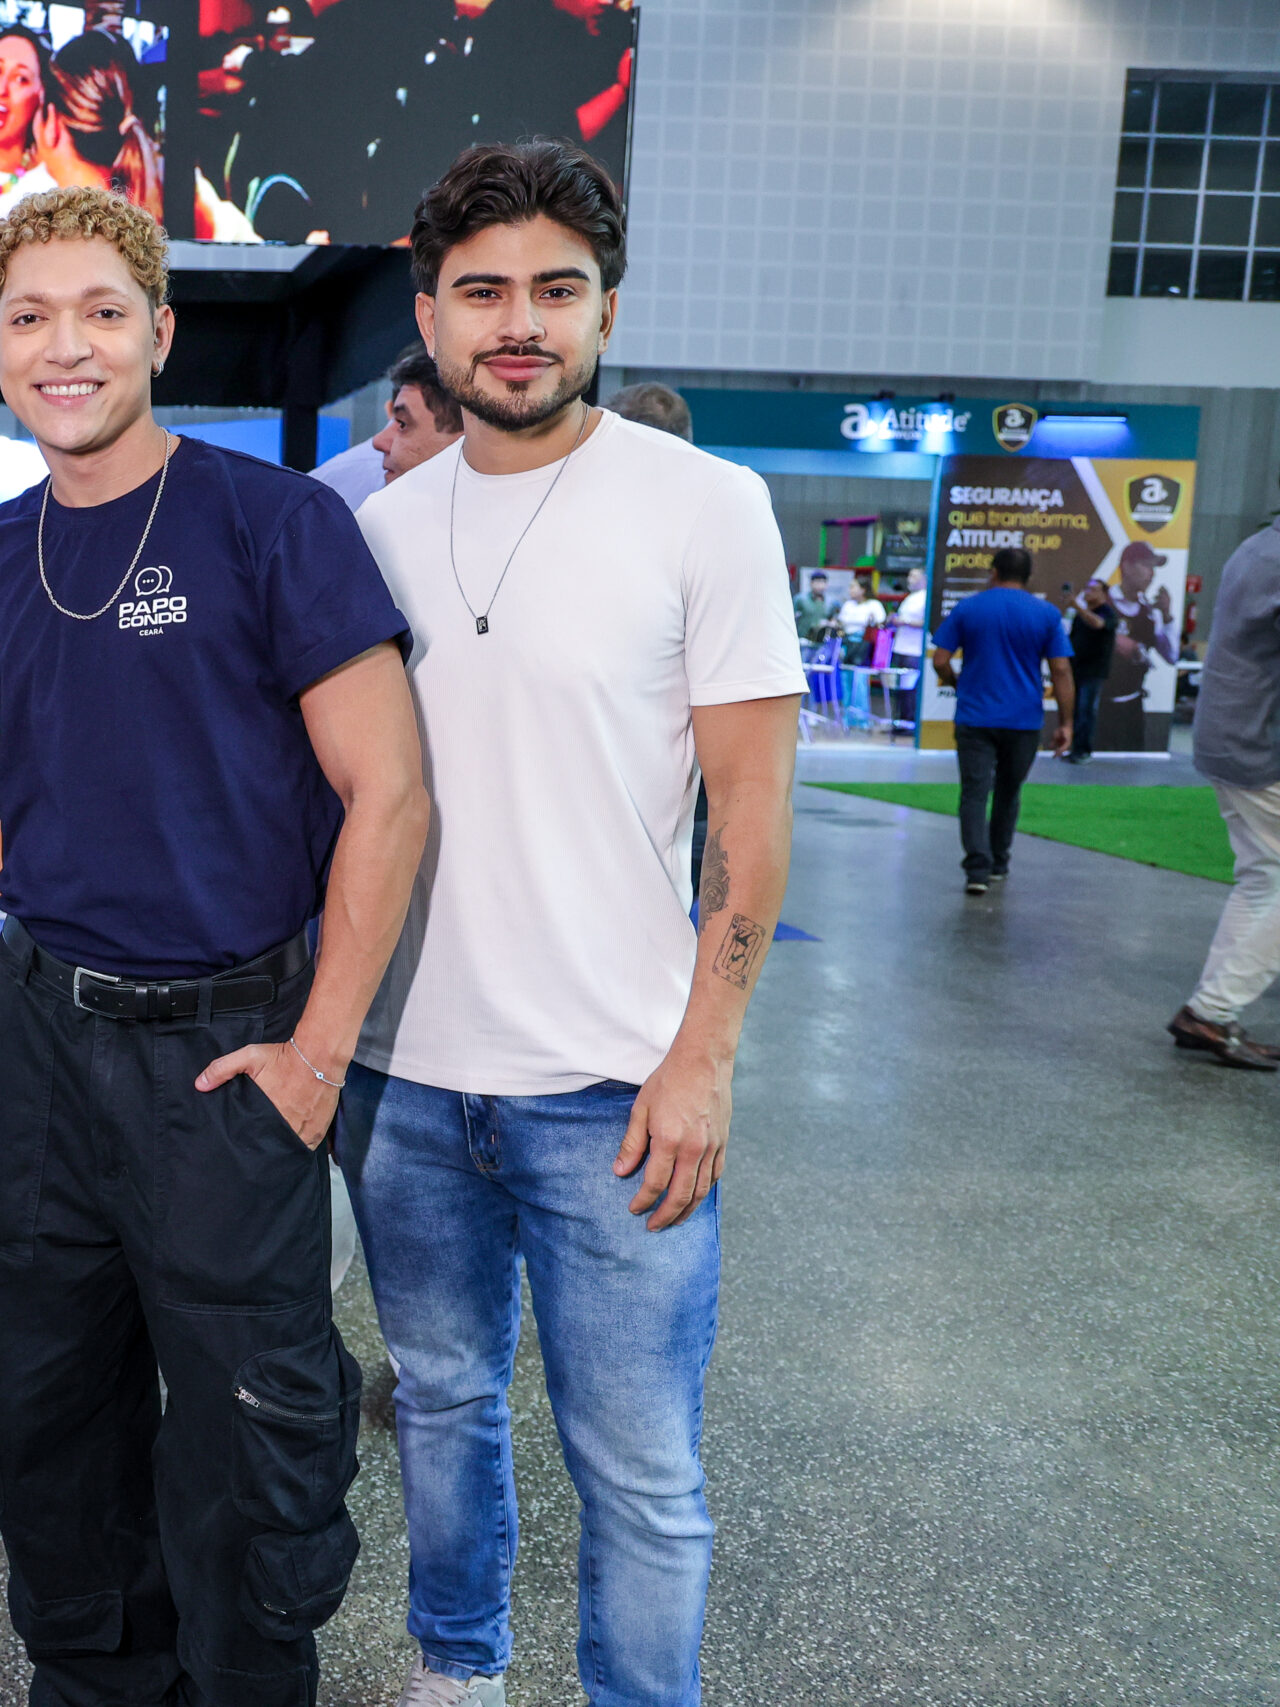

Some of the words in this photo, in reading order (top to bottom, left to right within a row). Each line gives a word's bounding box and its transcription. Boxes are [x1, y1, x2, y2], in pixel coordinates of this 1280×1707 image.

[949, 486, 1064, 512] SEGURANÇA
[948, 511, 986, 529] que
[946, 529, 1024, 548] ATITUDE
[1025, 533, 1062, 552] que
[119, 596, 187, 618] PAPO
[118, 610, 187, 629] CONDO
[139, 626, 164, 636] CEARÁ
